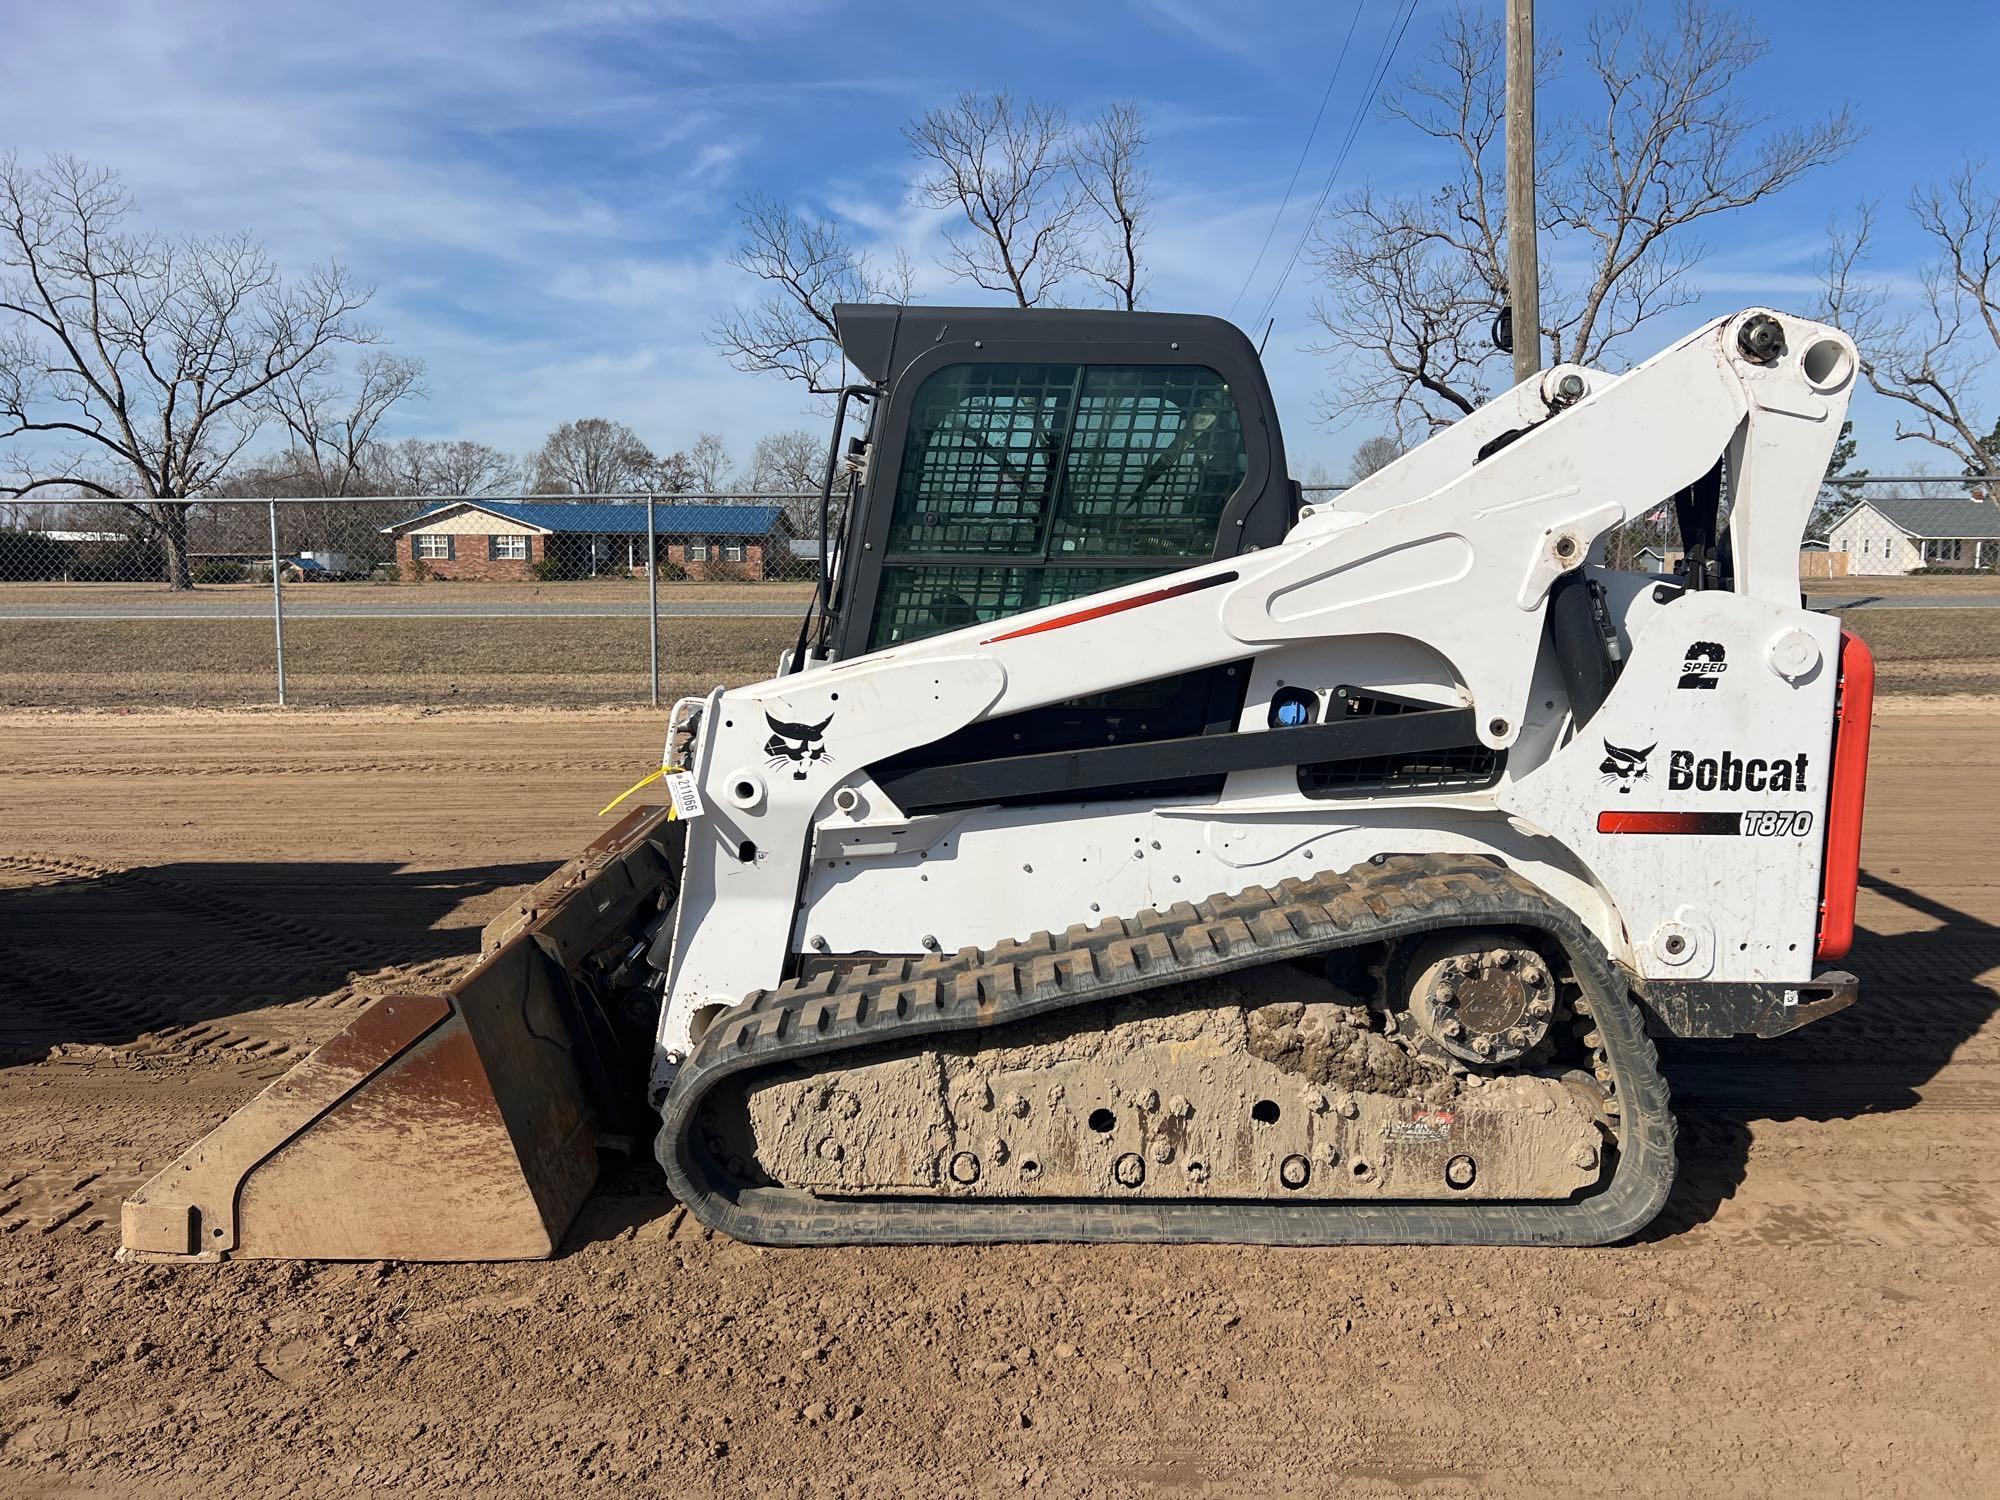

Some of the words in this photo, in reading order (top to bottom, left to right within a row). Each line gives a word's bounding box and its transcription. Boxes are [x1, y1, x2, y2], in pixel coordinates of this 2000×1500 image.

[1677, 641, 1725, 689] 2
[1682, 662, 1728, 672] SPEED
[1668, 750, 1809, 792] Bobcat
[678, 780, 698, 811] 211066
[1745, 811, 1813, 836] T870
